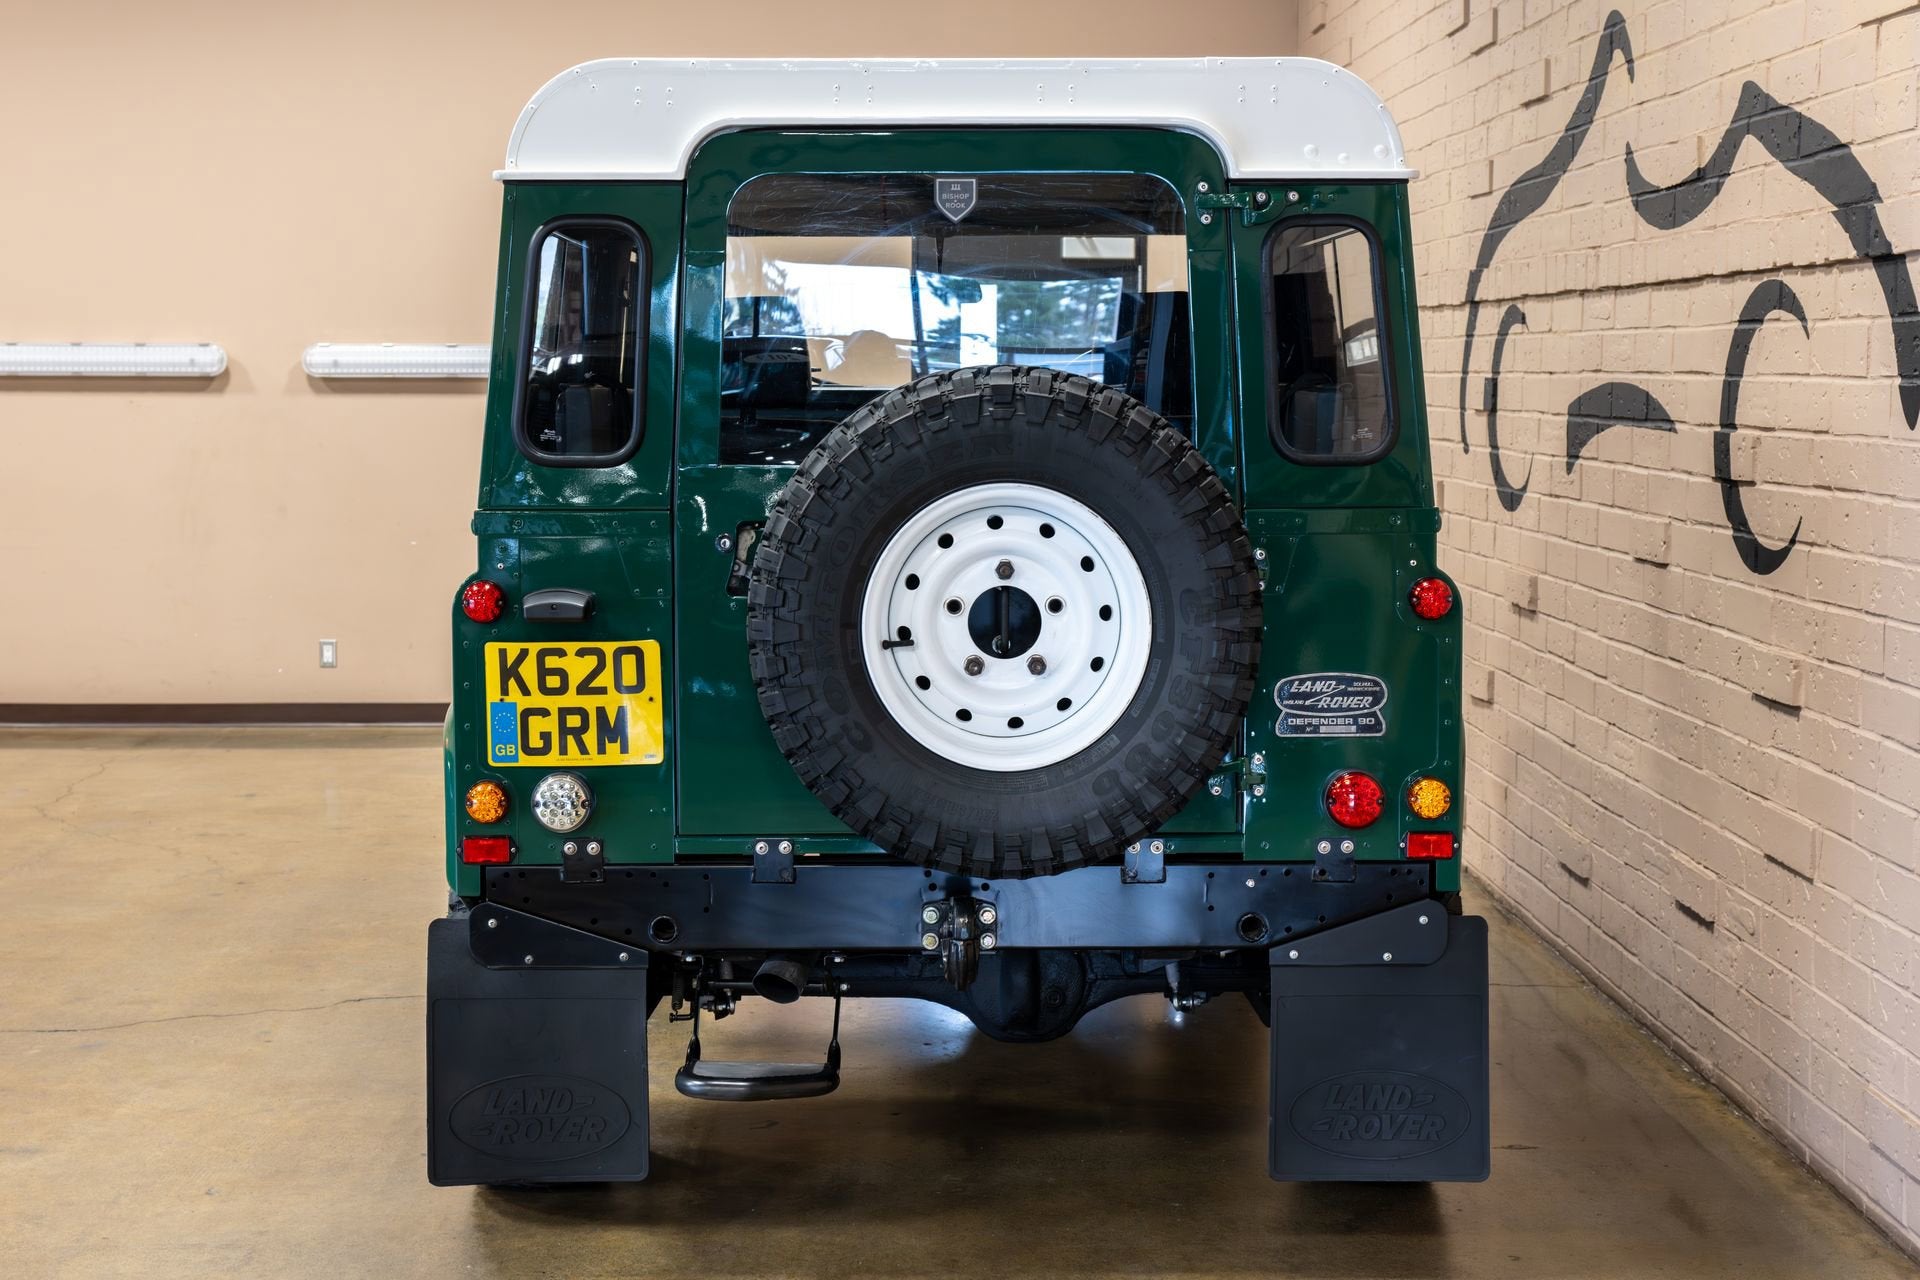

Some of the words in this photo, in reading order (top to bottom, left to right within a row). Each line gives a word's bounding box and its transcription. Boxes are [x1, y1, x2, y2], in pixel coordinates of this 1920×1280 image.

[498, 646, 646, 697] K620
[1290, 681, 1336, 692] LAND
[1318, 696, 1373, 708] ROVER
[520, 706, 630, 756] GRM
[495, 744, 516, 756] GB
[483, 1088, 574, 1115] LAND
[1323, 1085, 1413, 1111] LAND
[491, 1117, 607, 1145] ROVER
[1331, 1114, 1446, 1141] ROVER
